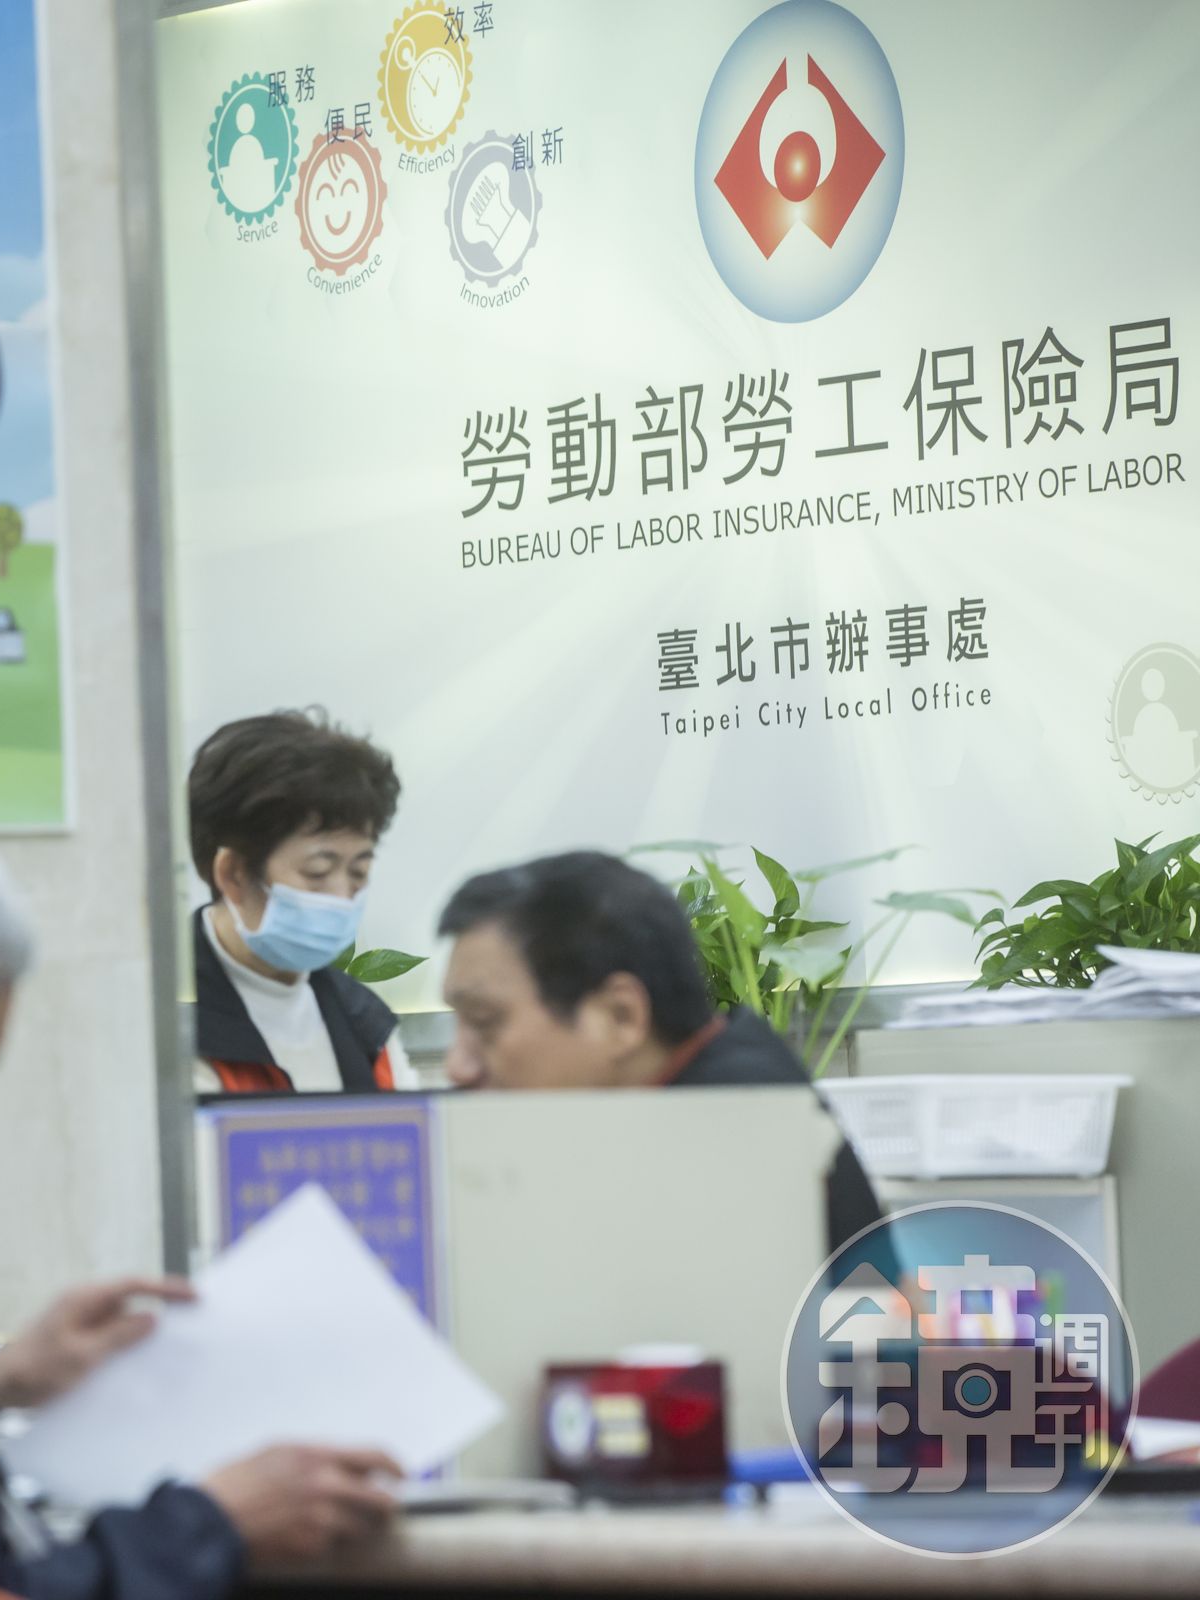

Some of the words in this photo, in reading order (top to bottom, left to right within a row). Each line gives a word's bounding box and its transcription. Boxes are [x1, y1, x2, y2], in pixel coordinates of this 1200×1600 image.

[444, 1, 495, 44] 效率
[267, 64, 316, 108] 服務
[324, 102, 373, 145] 便民
[398, 144, 456, 175] Efficiency
[511, 127, 564, 171] 創新
[236, 220, 279, 243] Service
[306, 253, 383, 295] Convenience
[459, 275, 530, 309] Innovation
[460, 317, 1182, 518] 勞動部勞工保險局
[461, 529, 561, 569] BUREAU
[570, 524, 605, 556] OF
[616, 513, 703, 550] LABOR
[713, 491, 881, 539] INSURANCE,
[893, 471, 1029, 517] MINISTRY
[1038, 465, 1078, 498] OF
[1087, 453, 1186, 493] LABOR
[657, 597, 989, 692] 臺北市辦事處
[661, 705, 740, 737] Taipei
[758, 701, 807, 729] City
[825, 688, 892, 720] Local
[912, 682, 992, 711] Office
